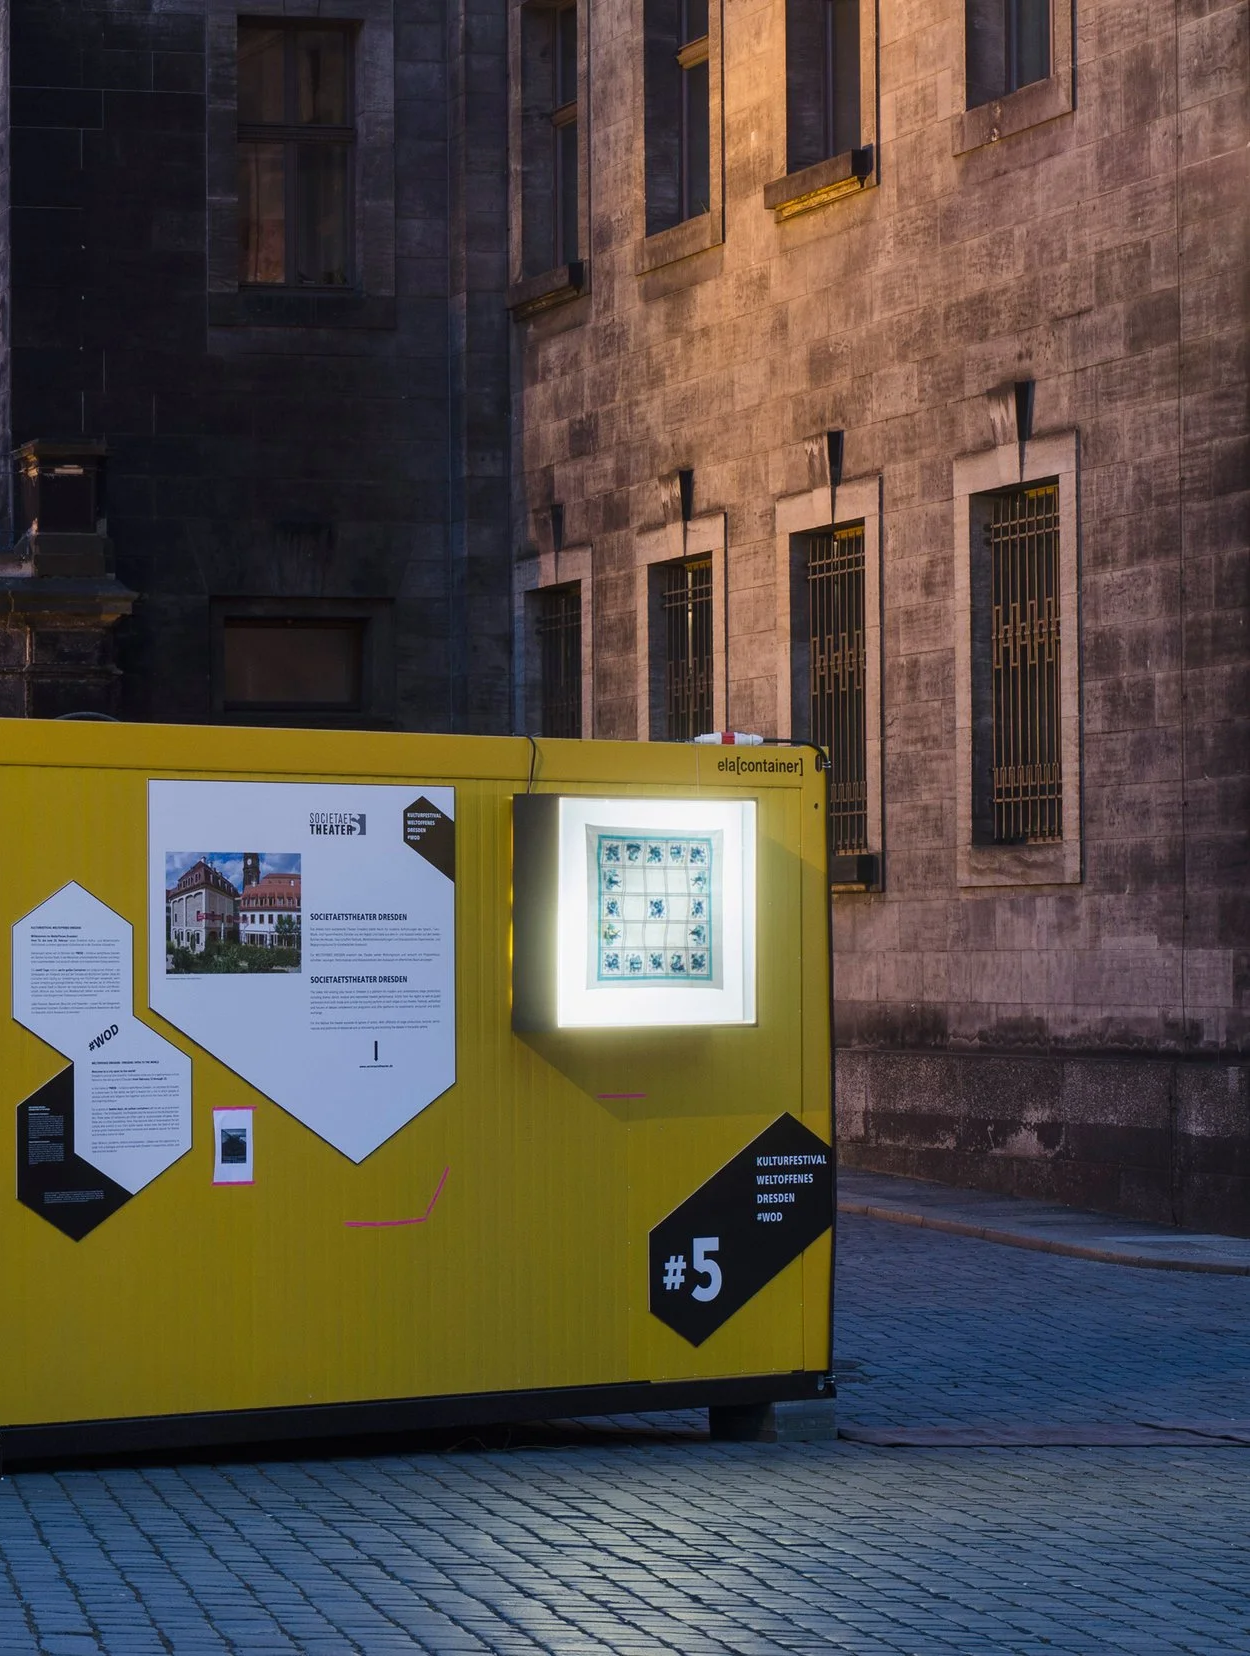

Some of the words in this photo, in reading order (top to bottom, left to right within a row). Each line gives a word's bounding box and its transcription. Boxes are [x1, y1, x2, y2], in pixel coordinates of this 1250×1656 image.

[717, 756, 804, 777] ela[container]
[309, 824, 353, 835] THEATER
[310, 913, 377, 921] SOCIETAETSTHEATER
[378, 913, 408, 921] DRESDEN
[310, 975, 377, 984] SOCIETAETSTHEATER
[378, 975, 408, 983] DRESDEN
[88, 1023, 119, 1052] #WOD
[756, 1154, 827, 1167] KULTURFESTIVAL
[756, 1173, 814, 1185] WELTOFFENES
[756, 1192, 796, 1204] DRESDEN
[756, 1212, 783, 1223] #WOD
[662, 1236, 723, 1303] #5
